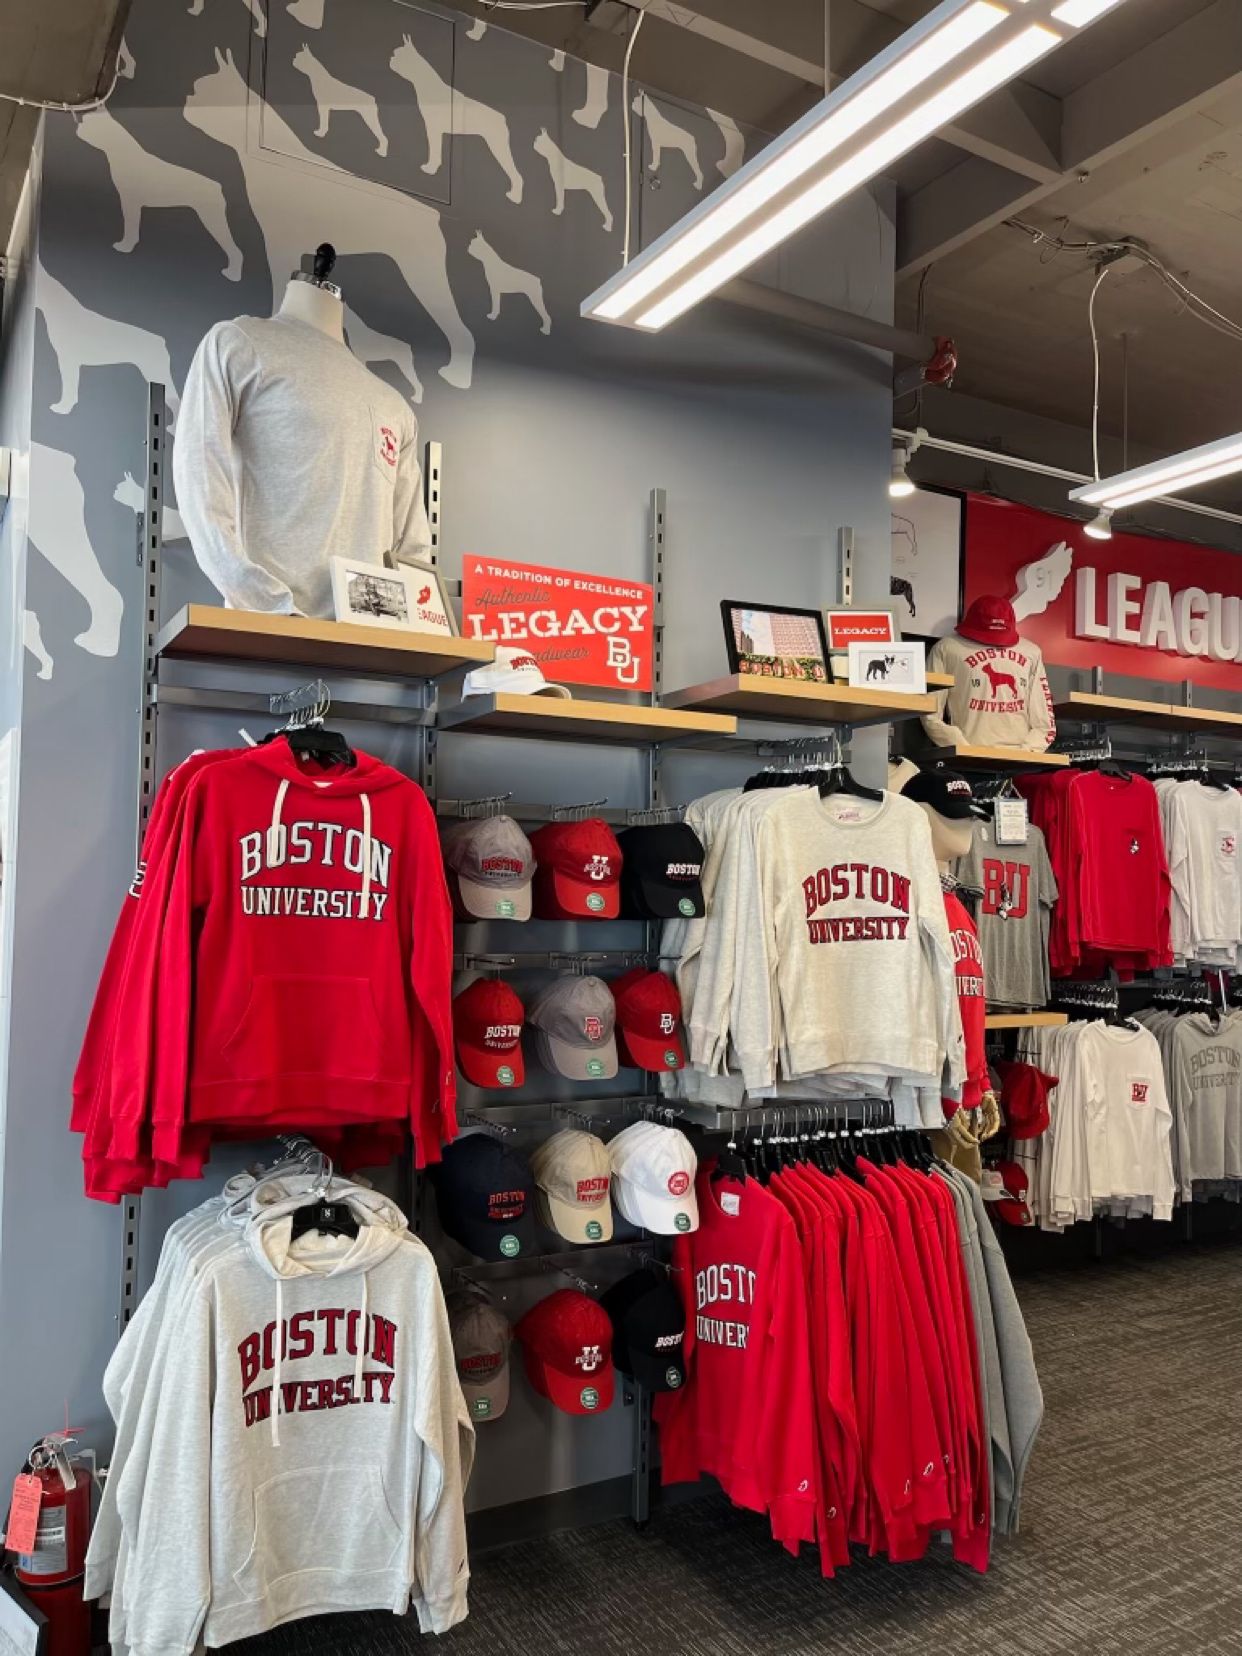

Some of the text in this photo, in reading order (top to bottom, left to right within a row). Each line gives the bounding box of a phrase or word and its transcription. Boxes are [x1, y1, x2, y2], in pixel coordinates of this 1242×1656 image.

[475, 565, 643, 599] A TRADITION OF EXCELLENCE
[467, 605, 647, 641] LEGACY
[834, 627, 887, 635] LEGACY
[1075, 566, 1242, 664] LEAGU
[533, 647, 590, 662] adwear
[606, 636, 640, 683] BU
[239, 822, 392, 889] BOSTON
[241, 885, 388, 922] UNIVERSITY
[802, 863, 911, 919] BOSTON
[981, 857, 1031, 919] BU
[806, 916, 910, 945] UNIVERSITY
[1190, 1045, 1241, 1076] BOSTON
[696, 1314, 749, 1349] UNIVER
[237, 1308, 398, 1394] BOSTON
